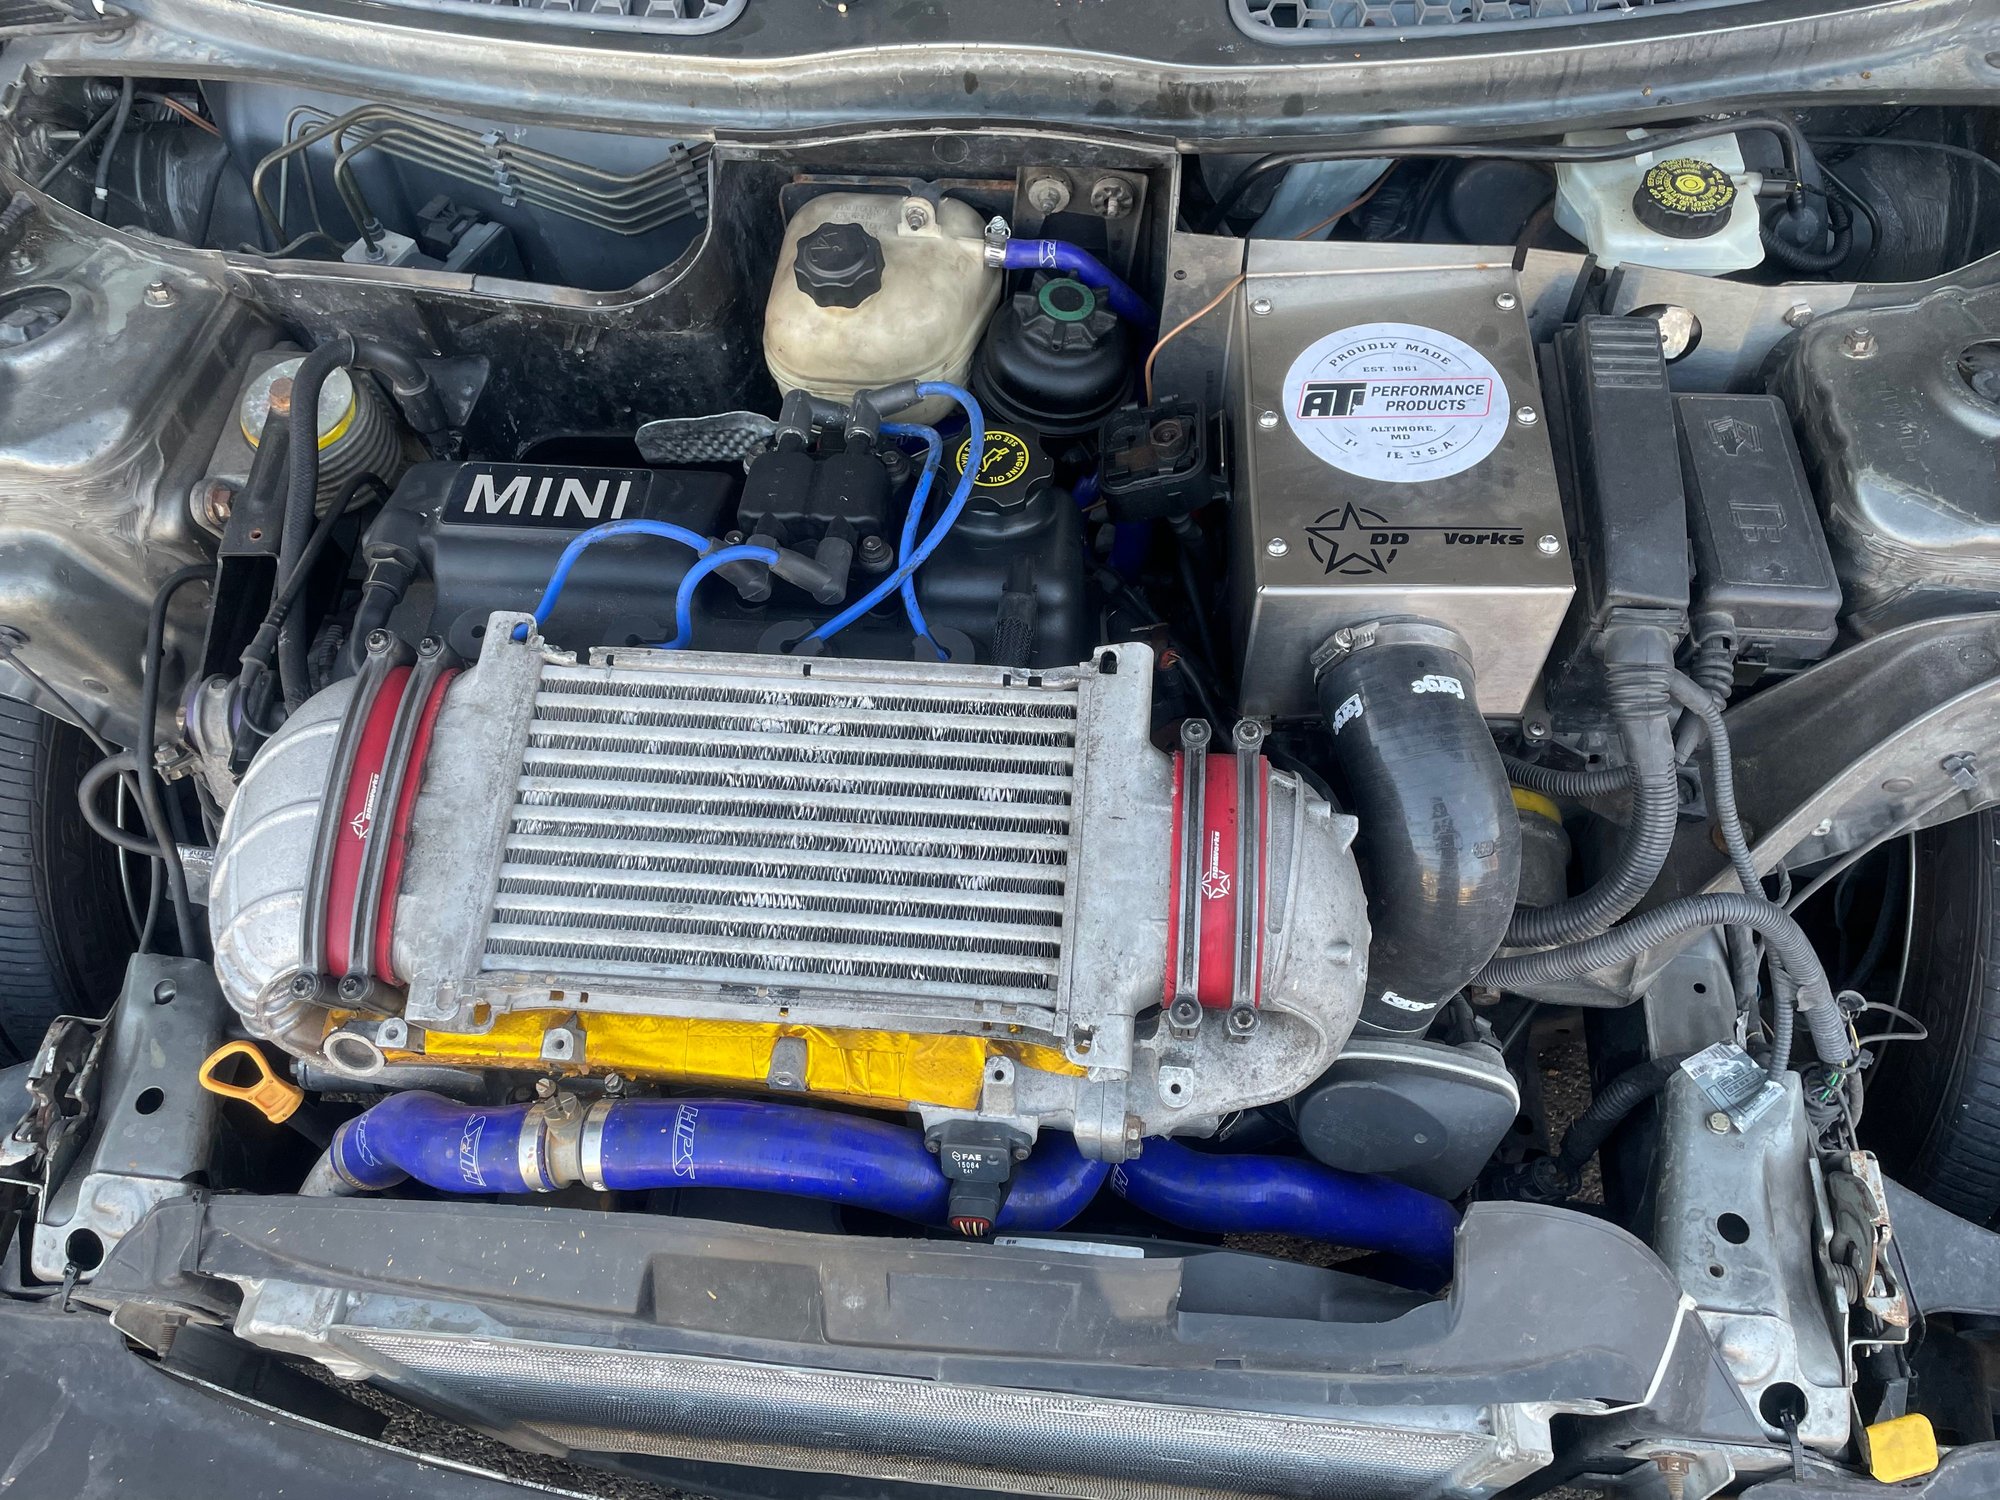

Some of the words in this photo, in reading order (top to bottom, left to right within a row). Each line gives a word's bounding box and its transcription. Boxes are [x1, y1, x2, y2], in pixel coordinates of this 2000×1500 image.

[1649, 188, 1662, 199] CAP
[1662, 198, 1686, 211] FILLER
[1690, 204, 1716, 212] CLEAN
[1330, 342, 1398, 368] PROUDLY
[1406, 344, 1452, 365] MADE
[1371, 384, 1484, 396] PERFORMANCE
[1386, 399, 1466, 411] PRODUCTS
[1003, 436, 1018, 447] SEE
[1006, 451, 1024, 478] ENGINE
[990, 475, 1005, 483] OIL
[464, 474, 632, 520] MINI
[1411, 675, 1465, 700] Forge
[1380, 990, 1438, 1012] Forge
[460, 1113, 487, 1187] HPS
[672, 1104, 698, 1180] HPS
